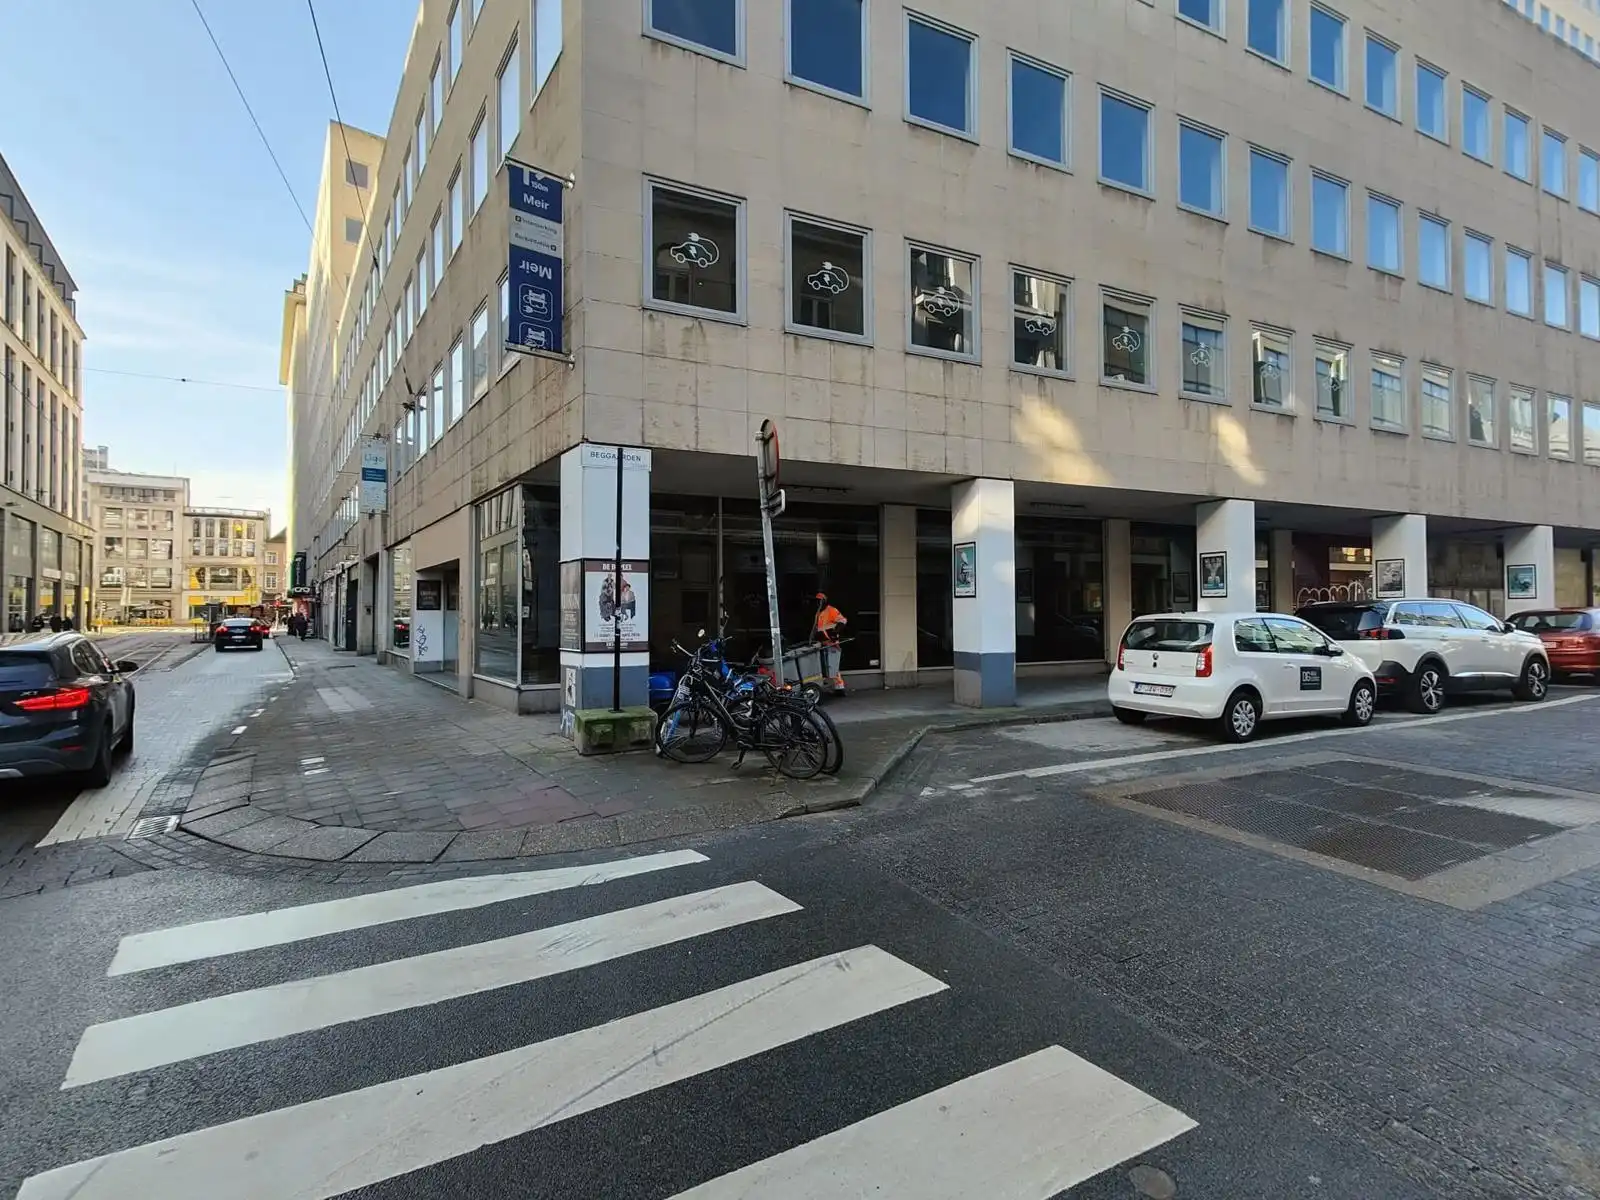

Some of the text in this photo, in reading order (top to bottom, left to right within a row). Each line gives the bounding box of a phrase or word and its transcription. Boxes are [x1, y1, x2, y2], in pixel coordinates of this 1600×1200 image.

[522, 193, 550, 210] Meir
[518, 260, 552, 280] Meir
[590, 451, 641, 462] BEGGARDEN
